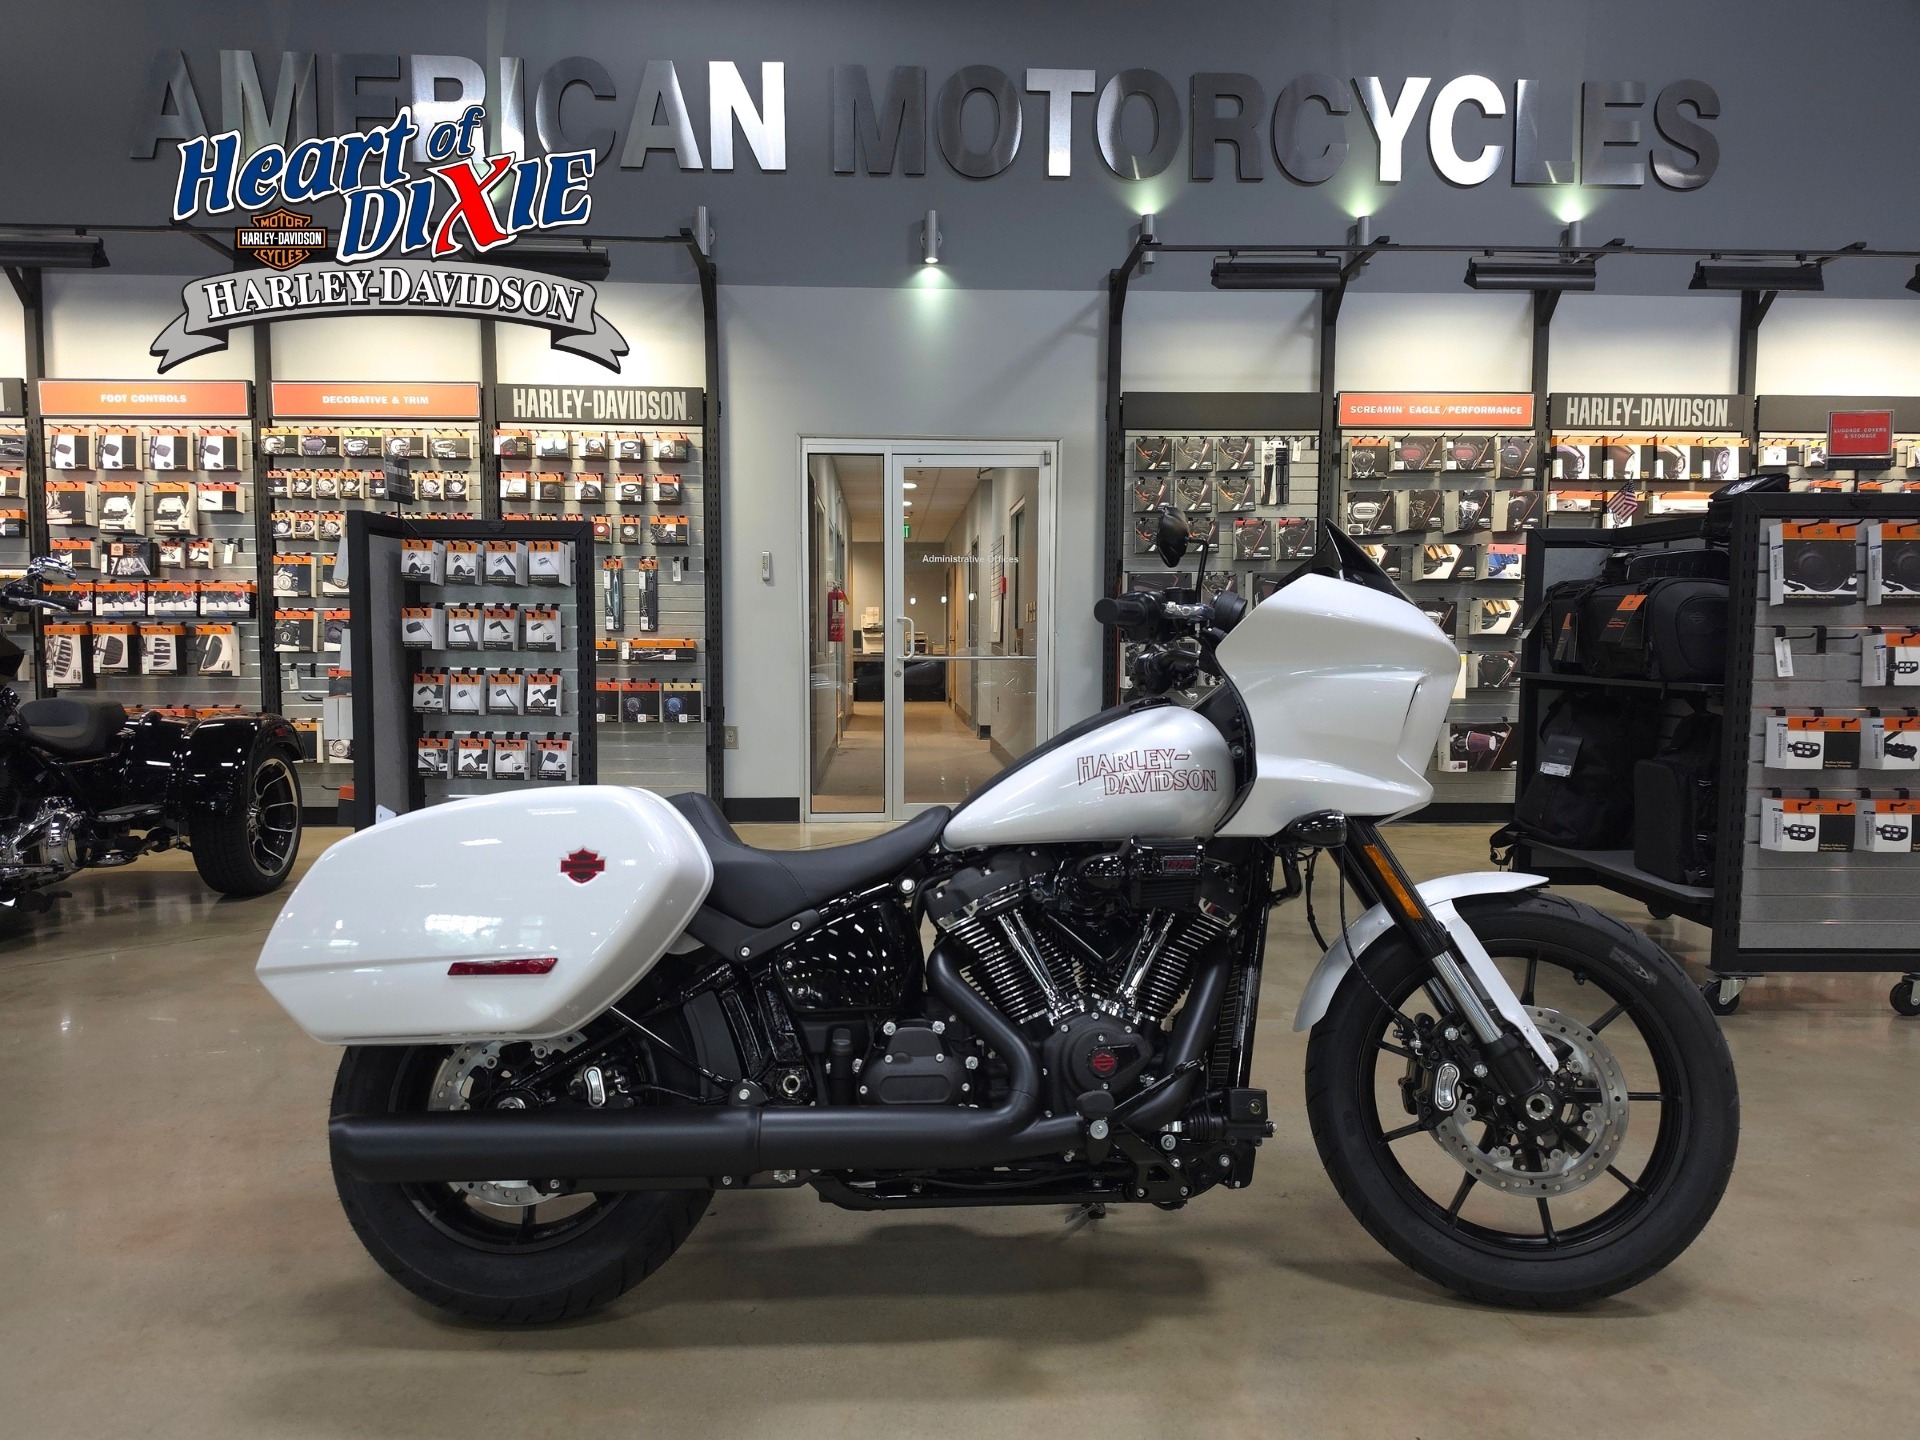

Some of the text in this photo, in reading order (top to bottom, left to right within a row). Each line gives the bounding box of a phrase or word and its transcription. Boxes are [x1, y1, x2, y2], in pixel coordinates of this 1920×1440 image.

[130, 49, 1720, 190] AMERICAN MOTORCYCLES
[100, 394, 187, 403] FOOT CONTROLS
[322, 395, 429, 404] DECORATIVE & TRIM
[512, 388, 688, 421] HARLEY-DAVIDSON
[1350, 405, 1406, 414] SCREAMIN'
[1566, 396, 1729, 427] HARLEY-DAVIDSON
[922, 554, 1019, 563] Administrative Offices
[1077, 749, 1190, 785] HARLEY-
[1103, 769, 1217, 795] DAVIDSON
